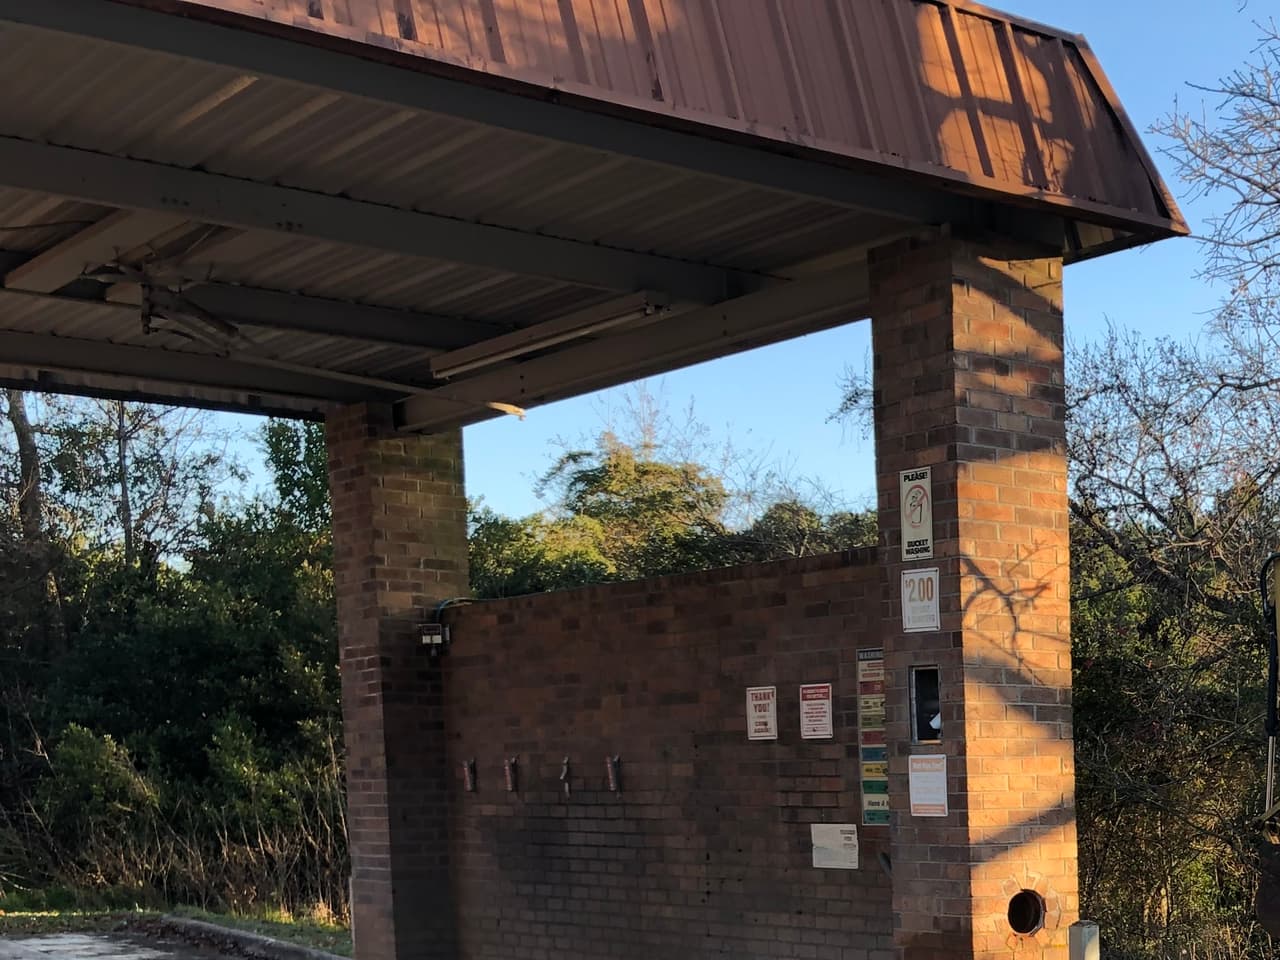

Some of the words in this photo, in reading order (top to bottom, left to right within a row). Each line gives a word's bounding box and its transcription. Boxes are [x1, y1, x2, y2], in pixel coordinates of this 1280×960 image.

[903, 472, 928, 482] PLEASE!
[907, 539, 928, 547] BUCKET
[905, 546, 930, 555] WASHING
